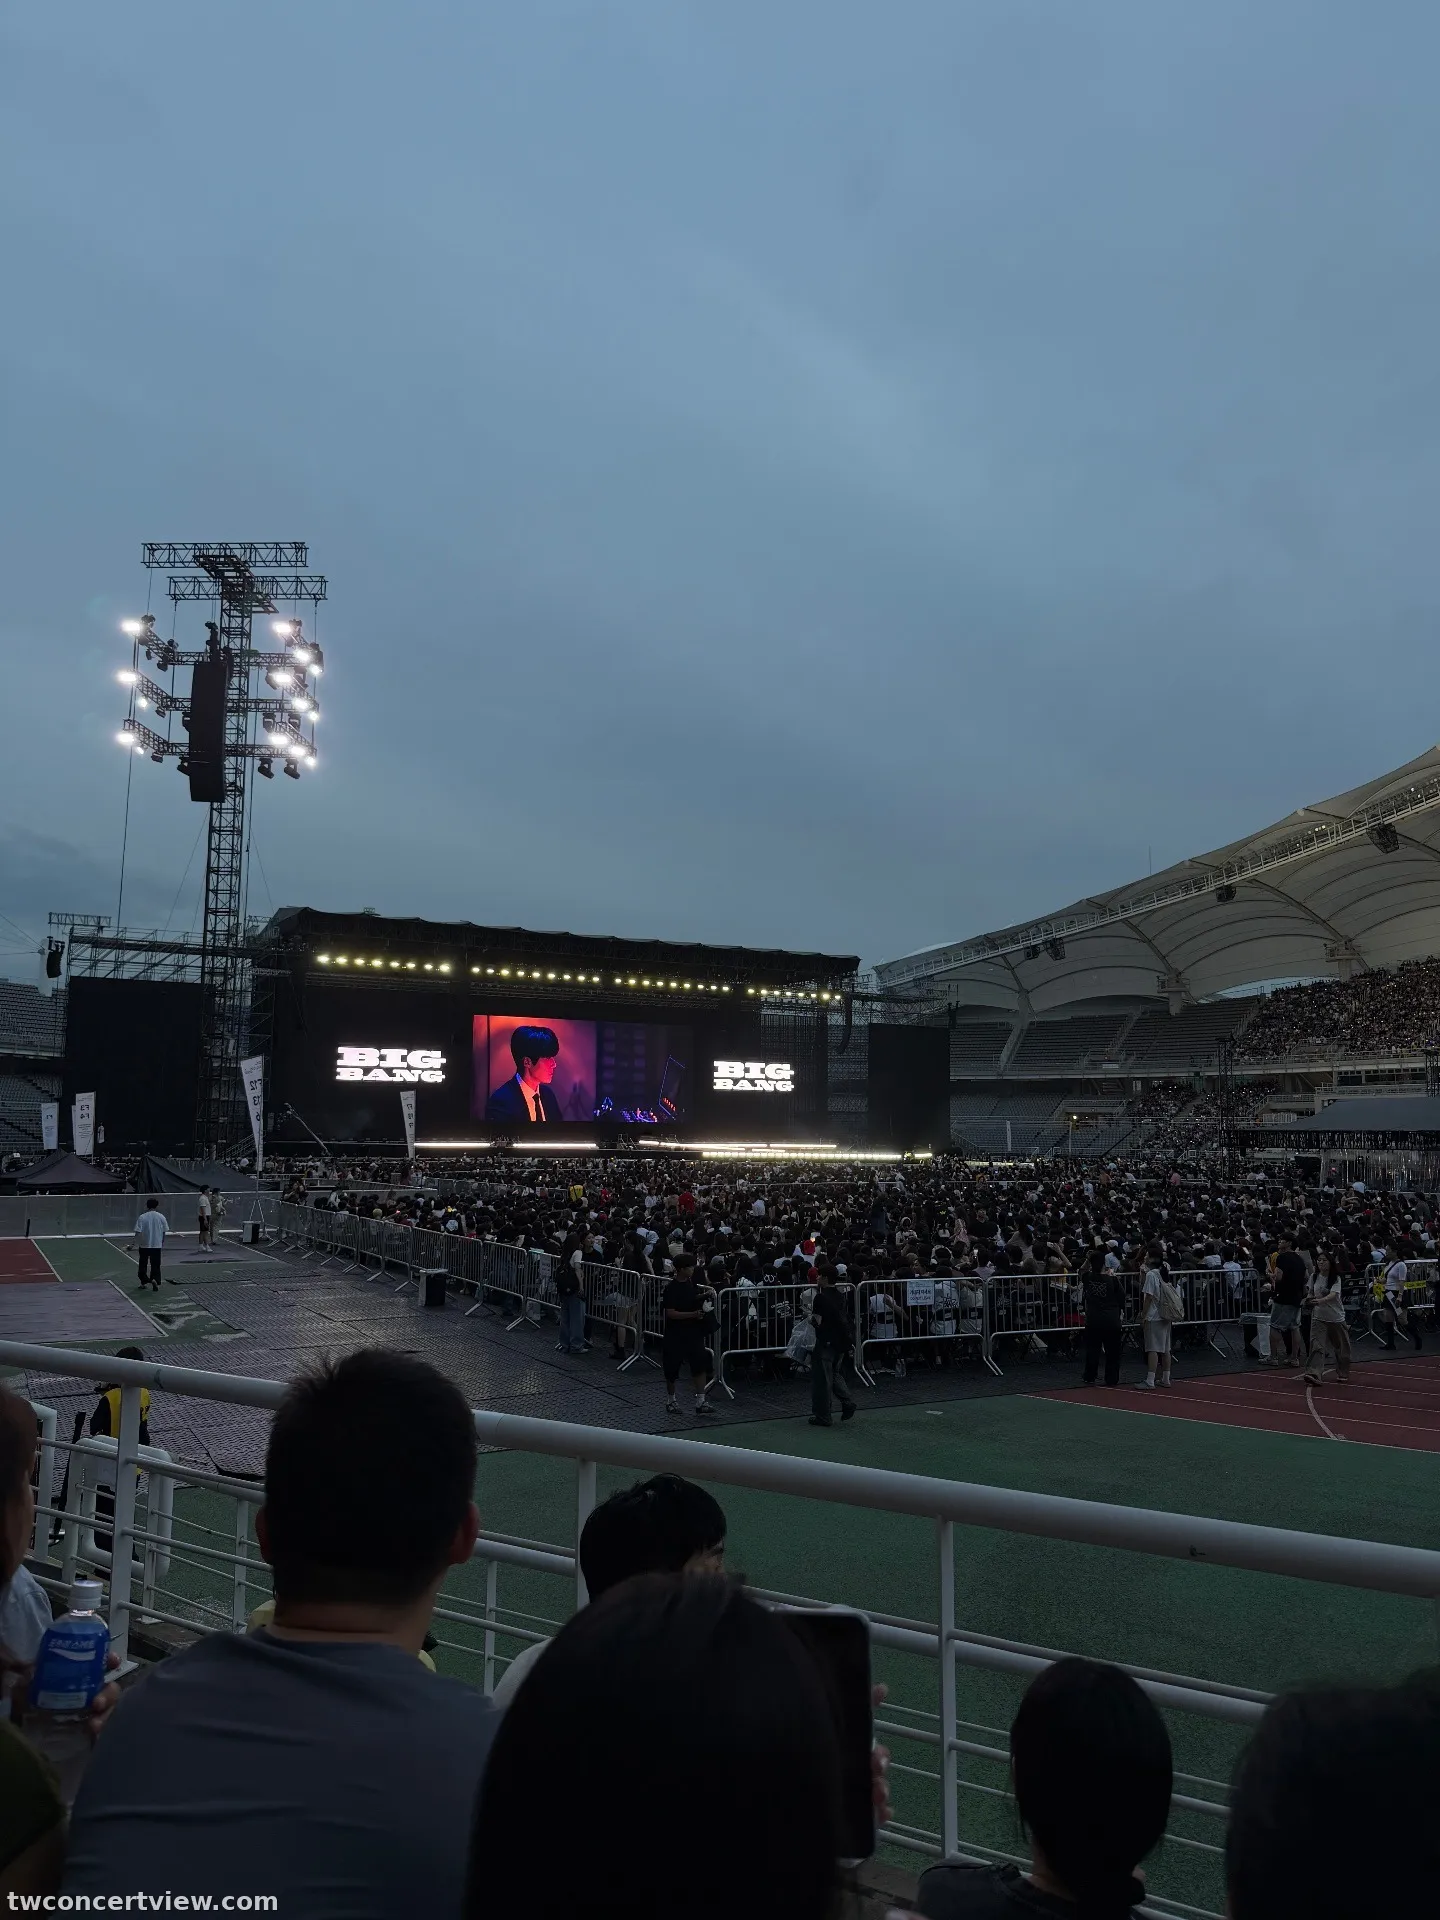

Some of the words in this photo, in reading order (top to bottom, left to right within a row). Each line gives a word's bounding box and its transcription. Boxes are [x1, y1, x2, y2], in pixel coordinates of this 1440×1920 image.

[337, 1047, 446, 1068] BIG
[336, 1068, 445, 1082] BANG
[714, 1061, 794, 1079] BIG
[713, 1079, 794, 1091] BANG
